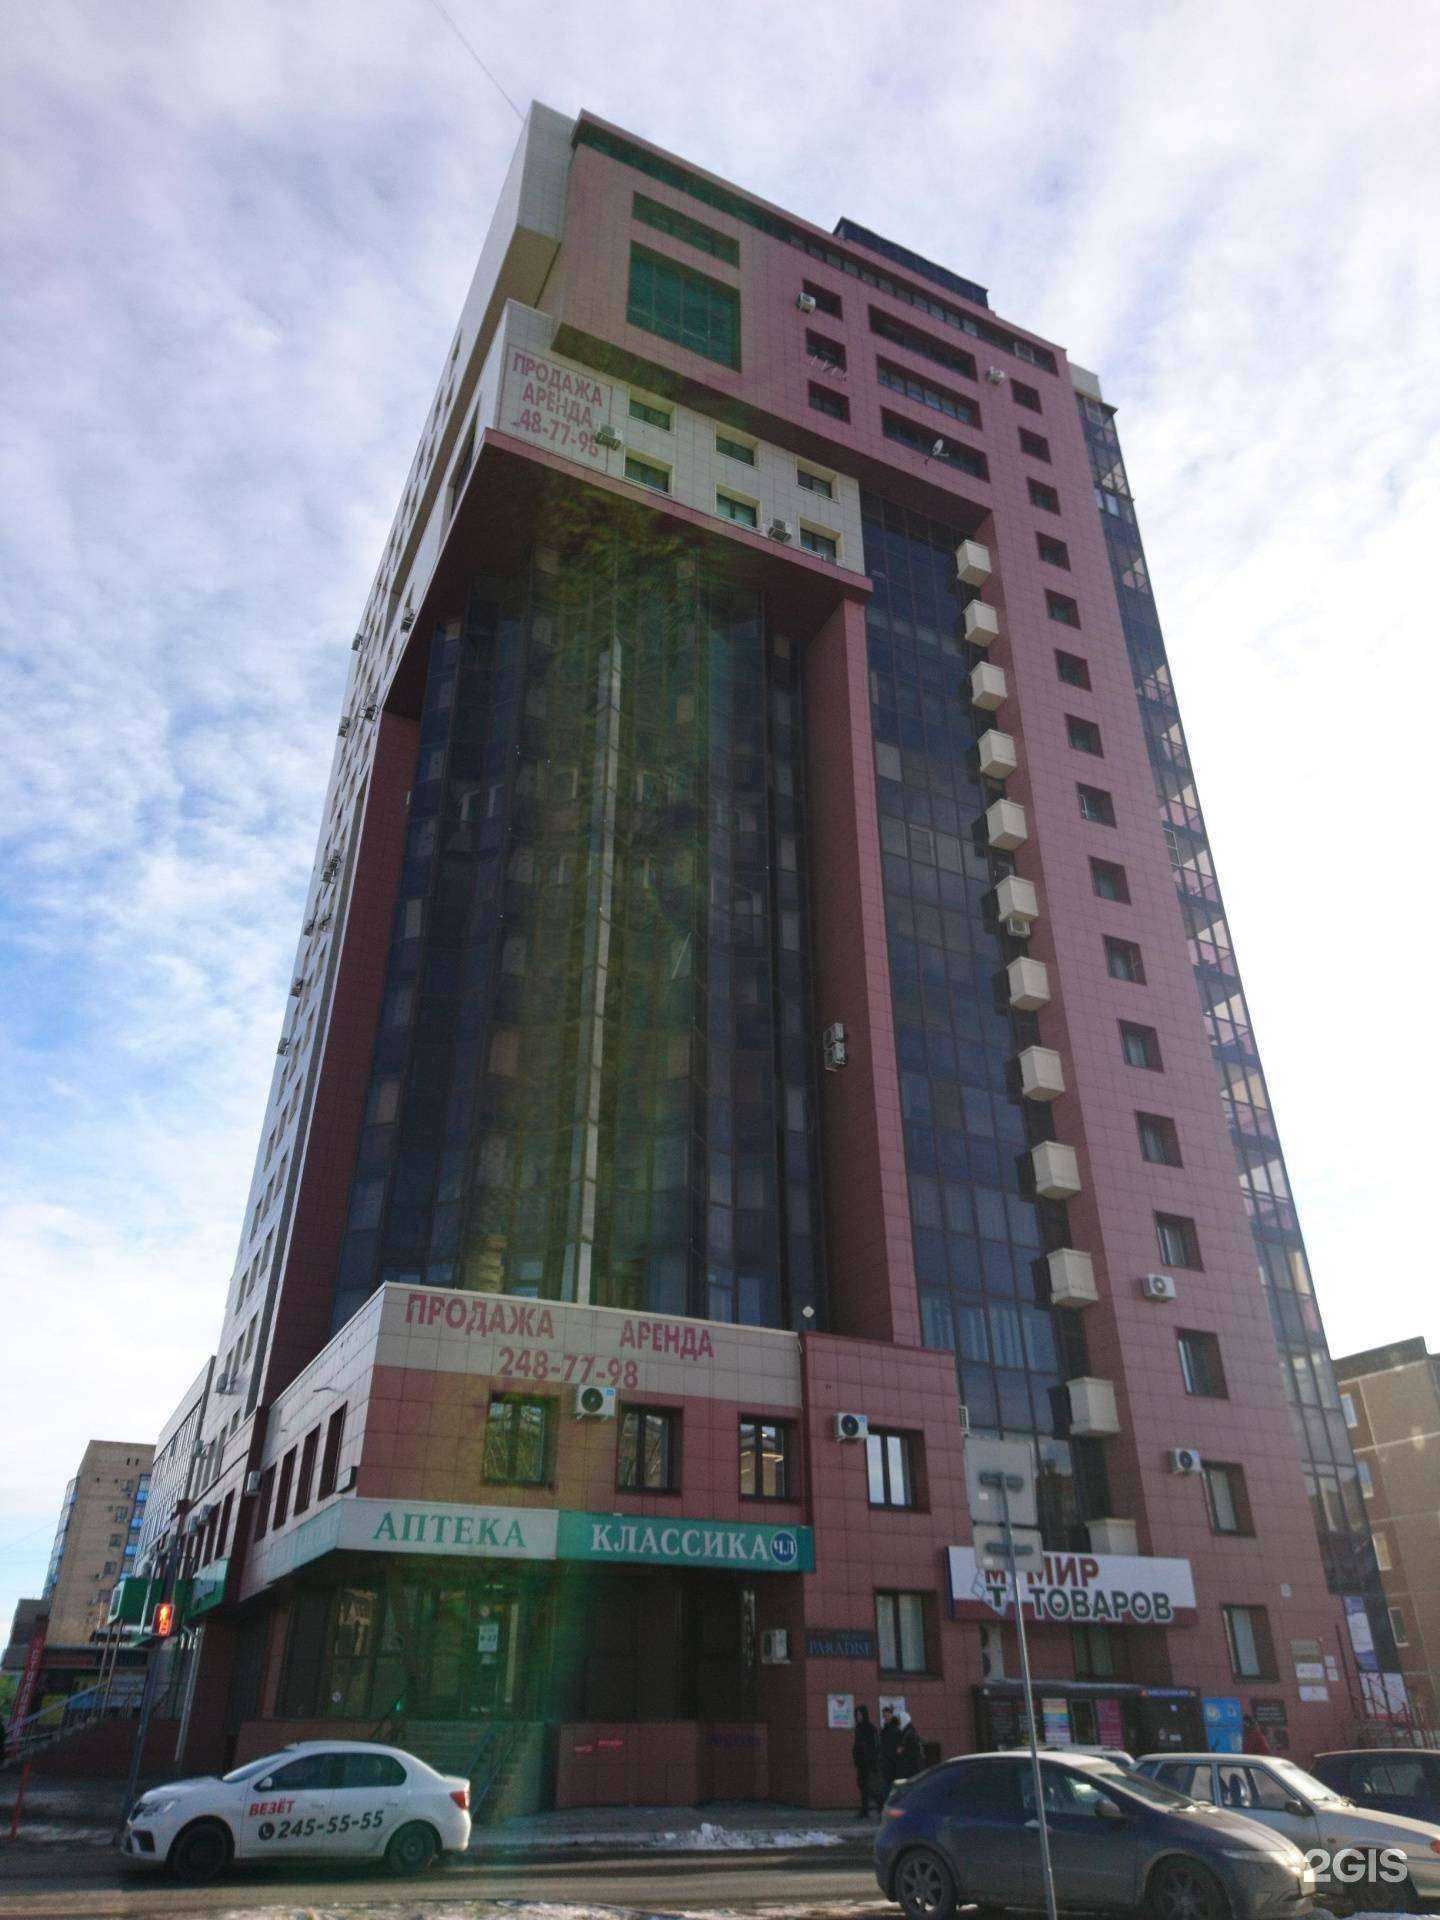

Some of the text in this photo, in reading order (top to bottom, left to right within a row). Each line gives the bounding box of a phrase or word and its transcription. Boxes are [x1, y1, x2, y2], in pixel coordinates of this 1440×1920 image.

[512, 352, 603, 408] ПРОДАЖА
[522, 382, 593, 428] АРЕНДА
[404, 1293, 715, 1361] ПРОДАЖА АРЕНДА
[499, 1347, 638, 1389] 248-77-98
[372, 1512, 527, 1548] АПТЕКА
[590, 1524, 768, 1561] КЛАССИКА
[1027, 1556, 1099, 1588] МИР
[1029, 1587, 1173, 1621] ТОВАРОВ
[249, 1798, 295, 1816] ВЕЗЁТ
[278, 1809, 384, 1839] 245-55-55
